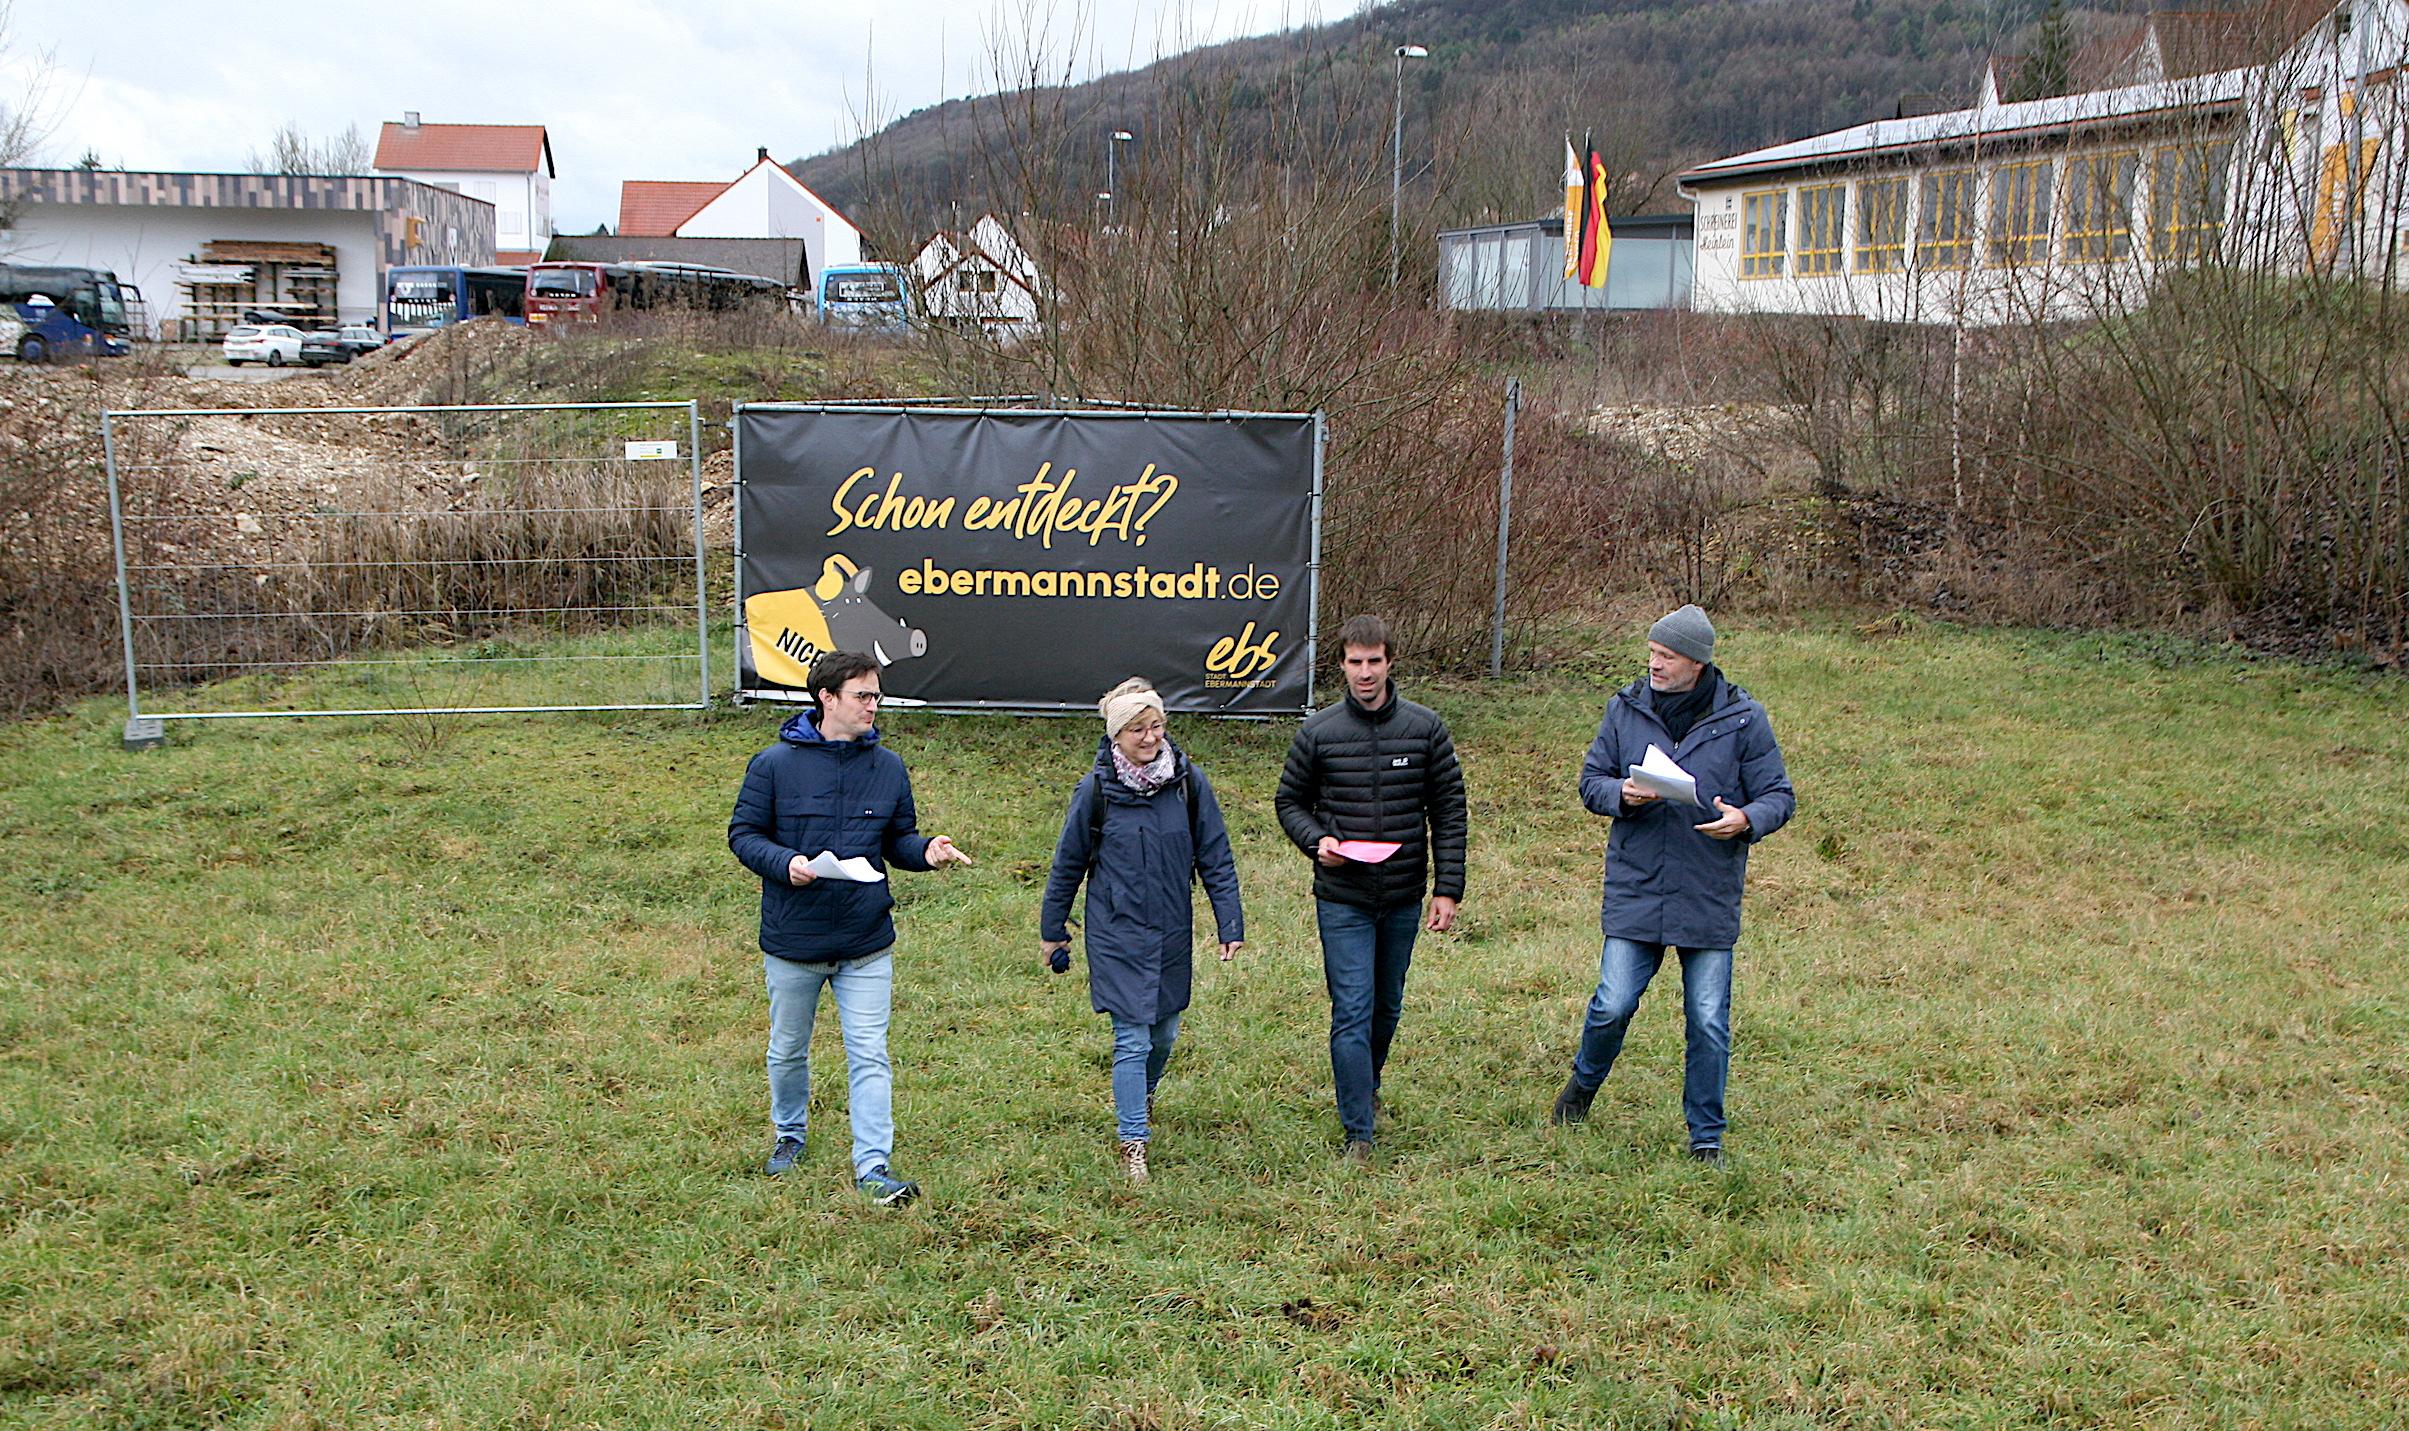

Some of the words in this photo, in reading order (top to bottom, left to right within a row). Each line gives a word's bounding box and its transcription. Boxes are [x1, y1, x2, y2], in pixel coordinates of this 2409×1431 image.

[826, 466, 956, 536] Schon
[963, 461, 1179, 549] entdeckt?
[898, 558, 1280, 600] ebermannstadt.de
[1205, 621, 1280, 678] ebs
[1204, 680, 1277, 688] EBERMANNSTADT
